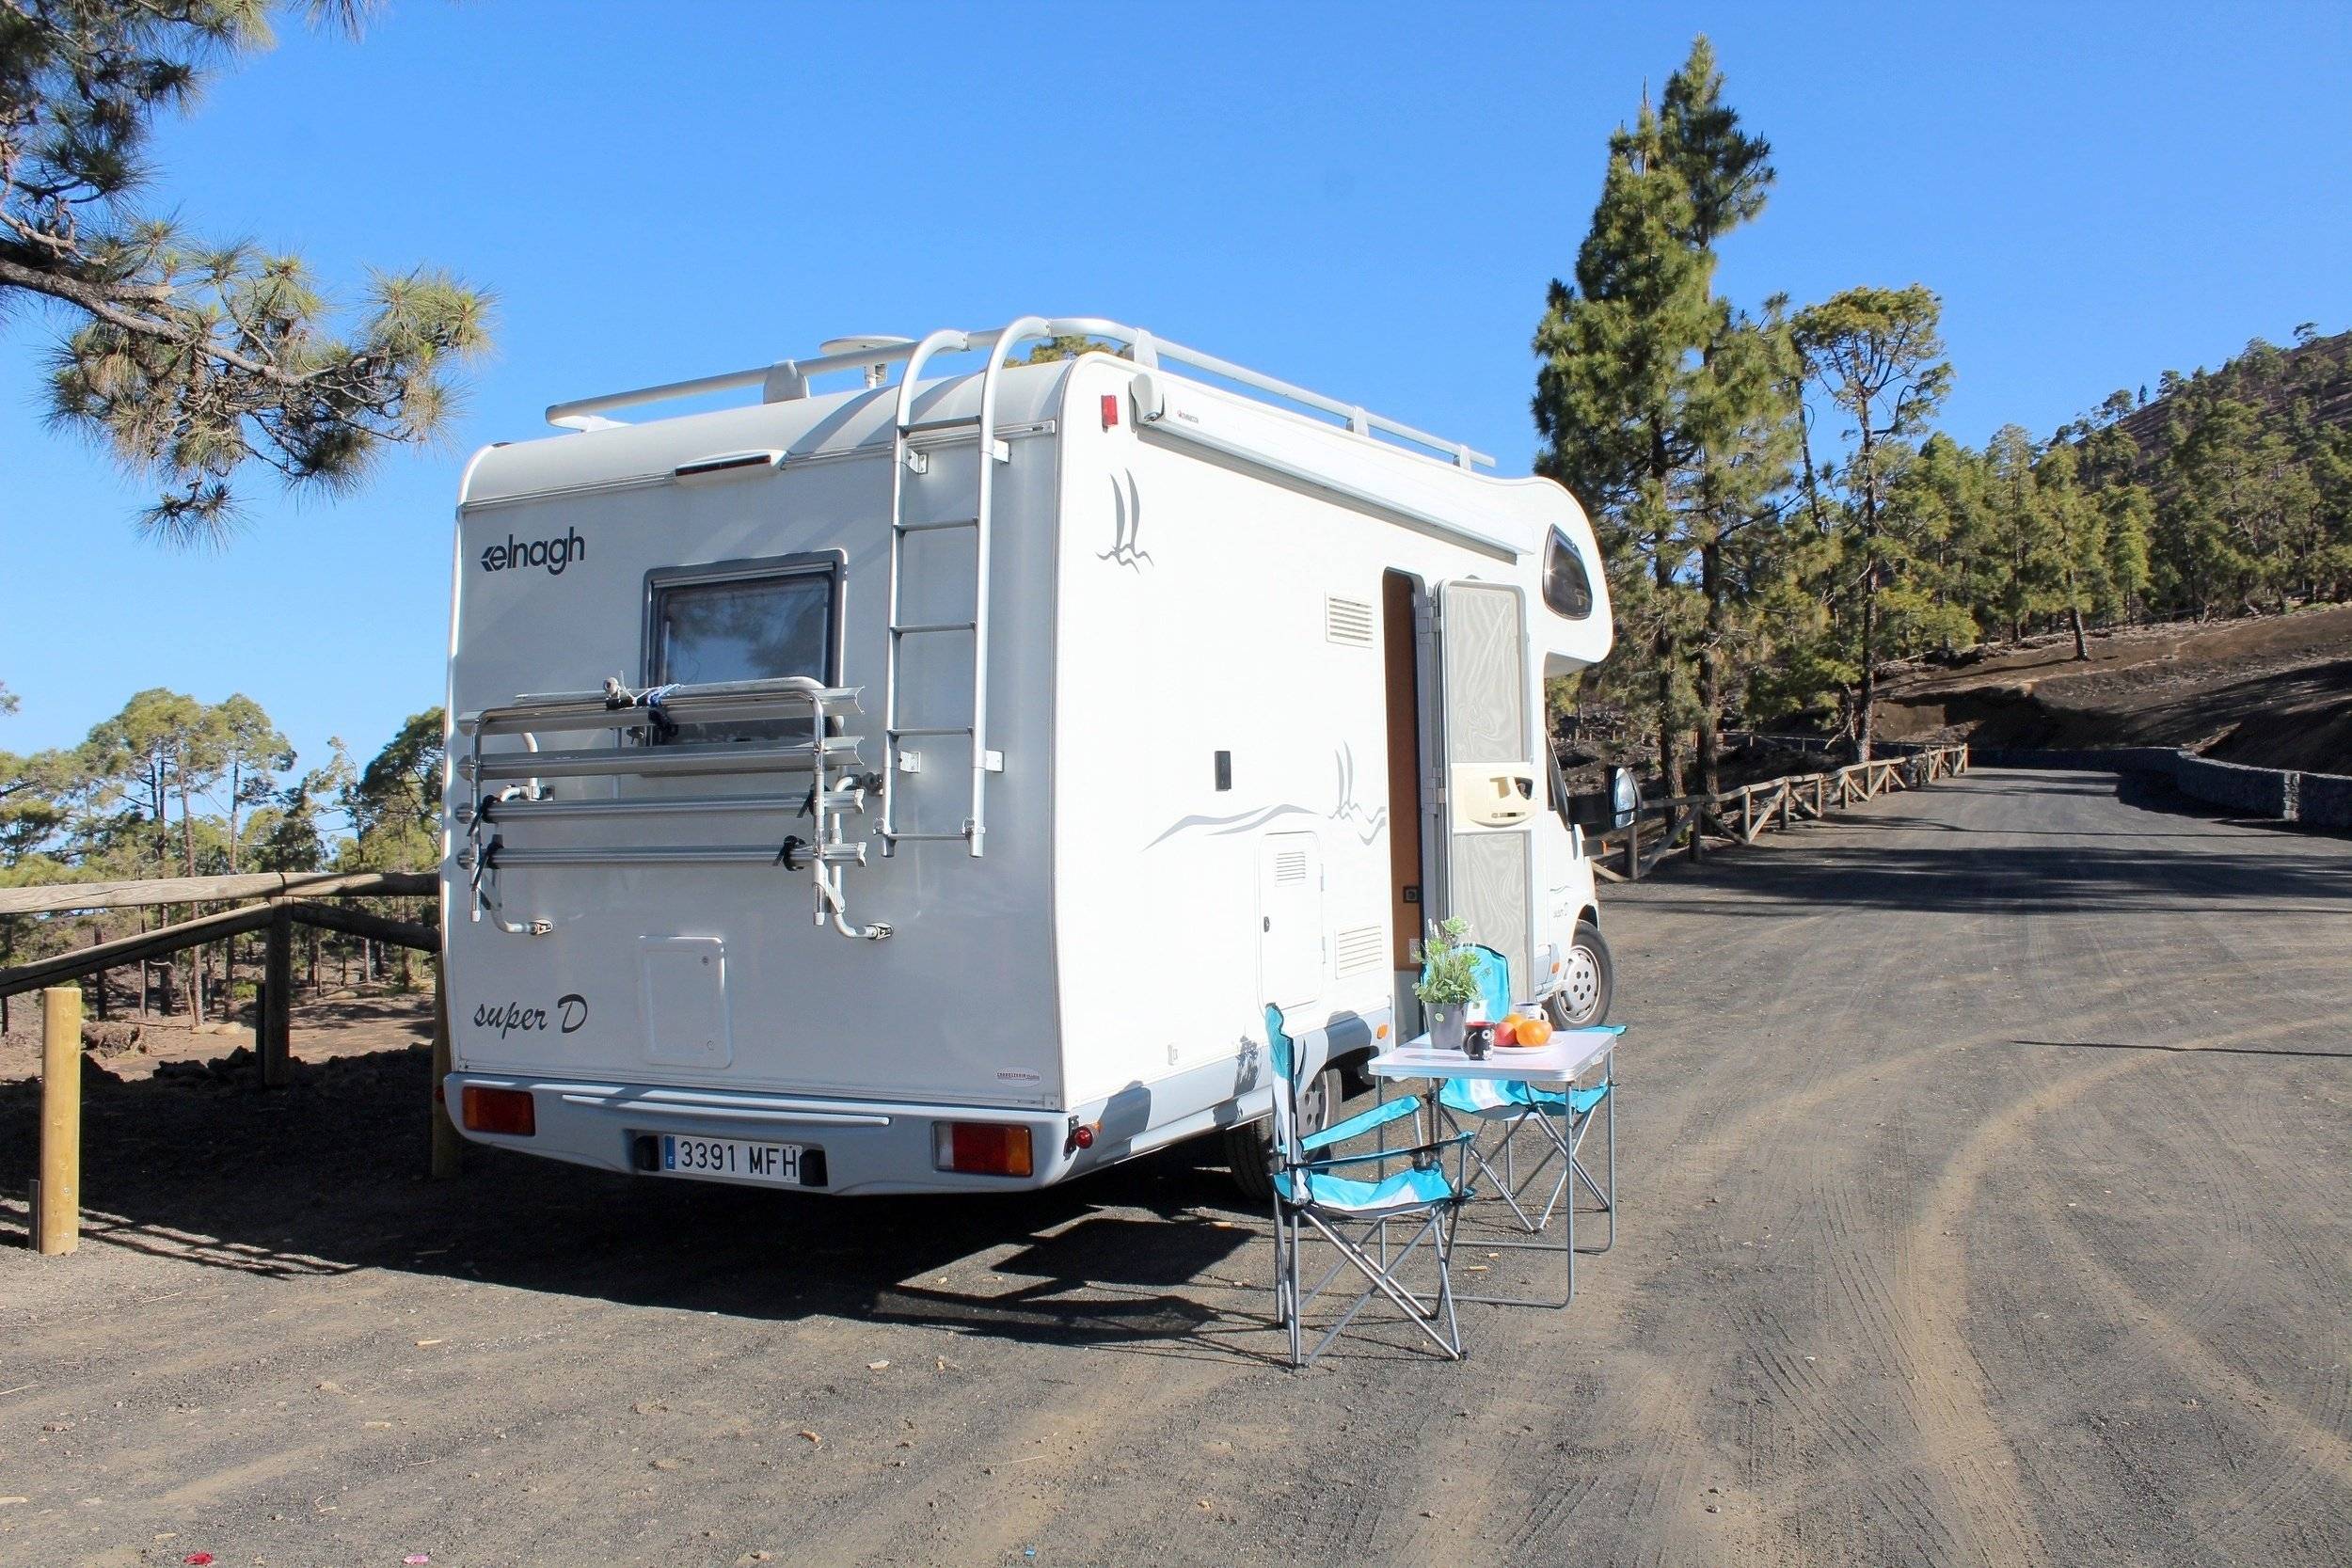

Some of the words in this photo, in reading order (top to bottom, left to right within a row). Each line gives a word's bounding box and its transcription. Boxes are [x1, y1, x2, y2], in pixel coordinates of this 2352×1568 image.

[487, 526, 585, 576] elnagh
[473, 1002, 548, 1039] super
[557, 993, 588, 1033] D
[680, 1141, 735, 1172] 3391
[749, 1146, 797, 1177] MFH
